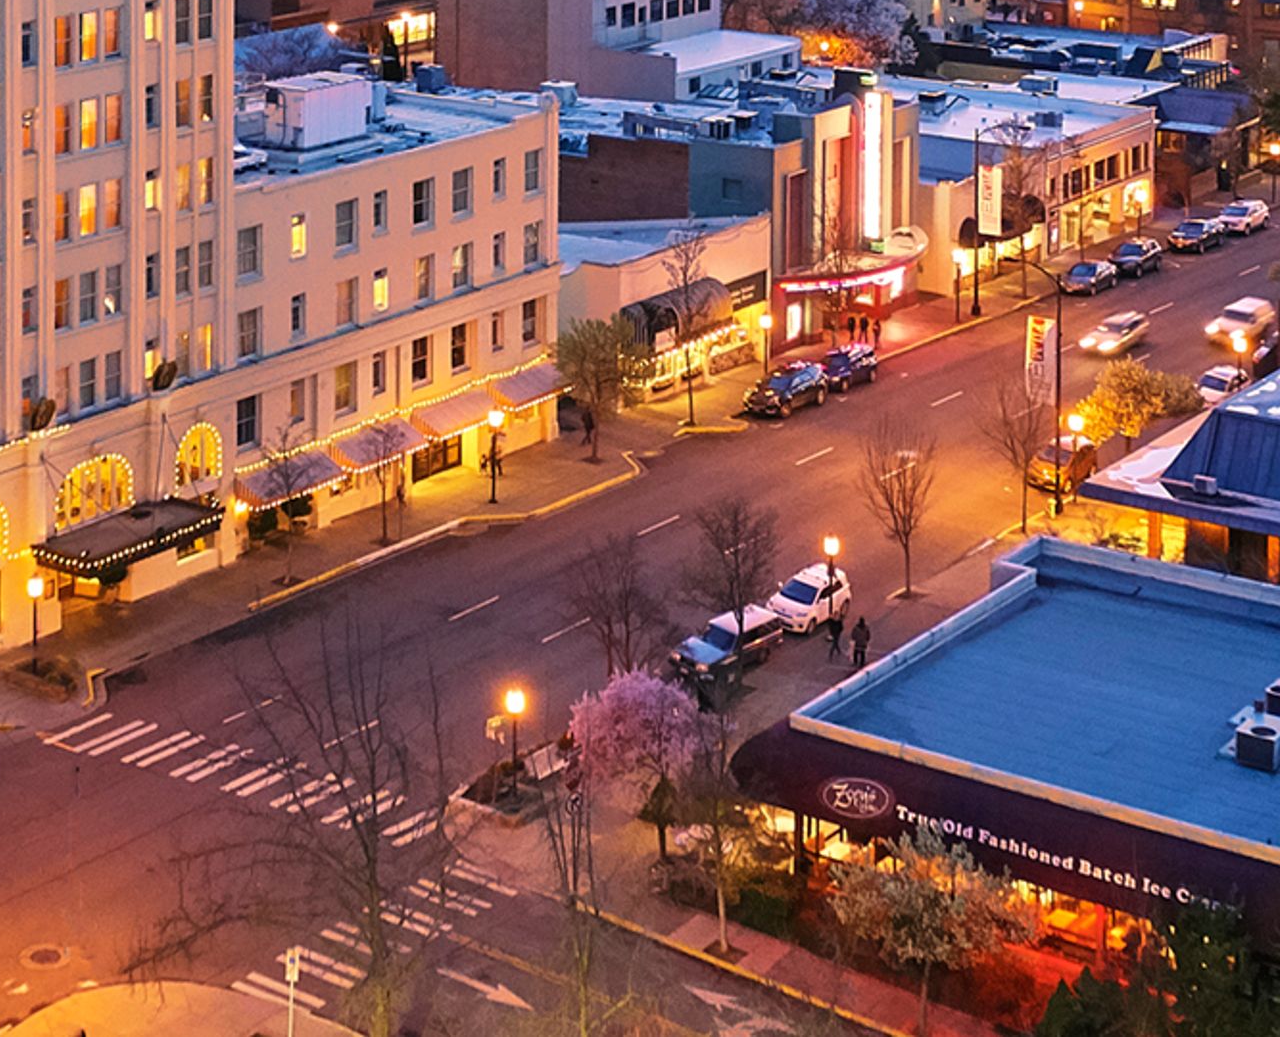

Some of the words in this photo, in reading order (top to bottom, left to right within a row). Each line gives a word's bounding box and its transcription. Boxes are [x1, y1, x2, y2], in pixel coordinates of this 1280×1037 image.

[896, 804, 940, 833] True
[943, 819, 974, 839] Old
[978, 828, 1075, 871] Fashioned
[1078, 859, 1137, 890] Batch
[1142, 877, 1171, 900] Ice
